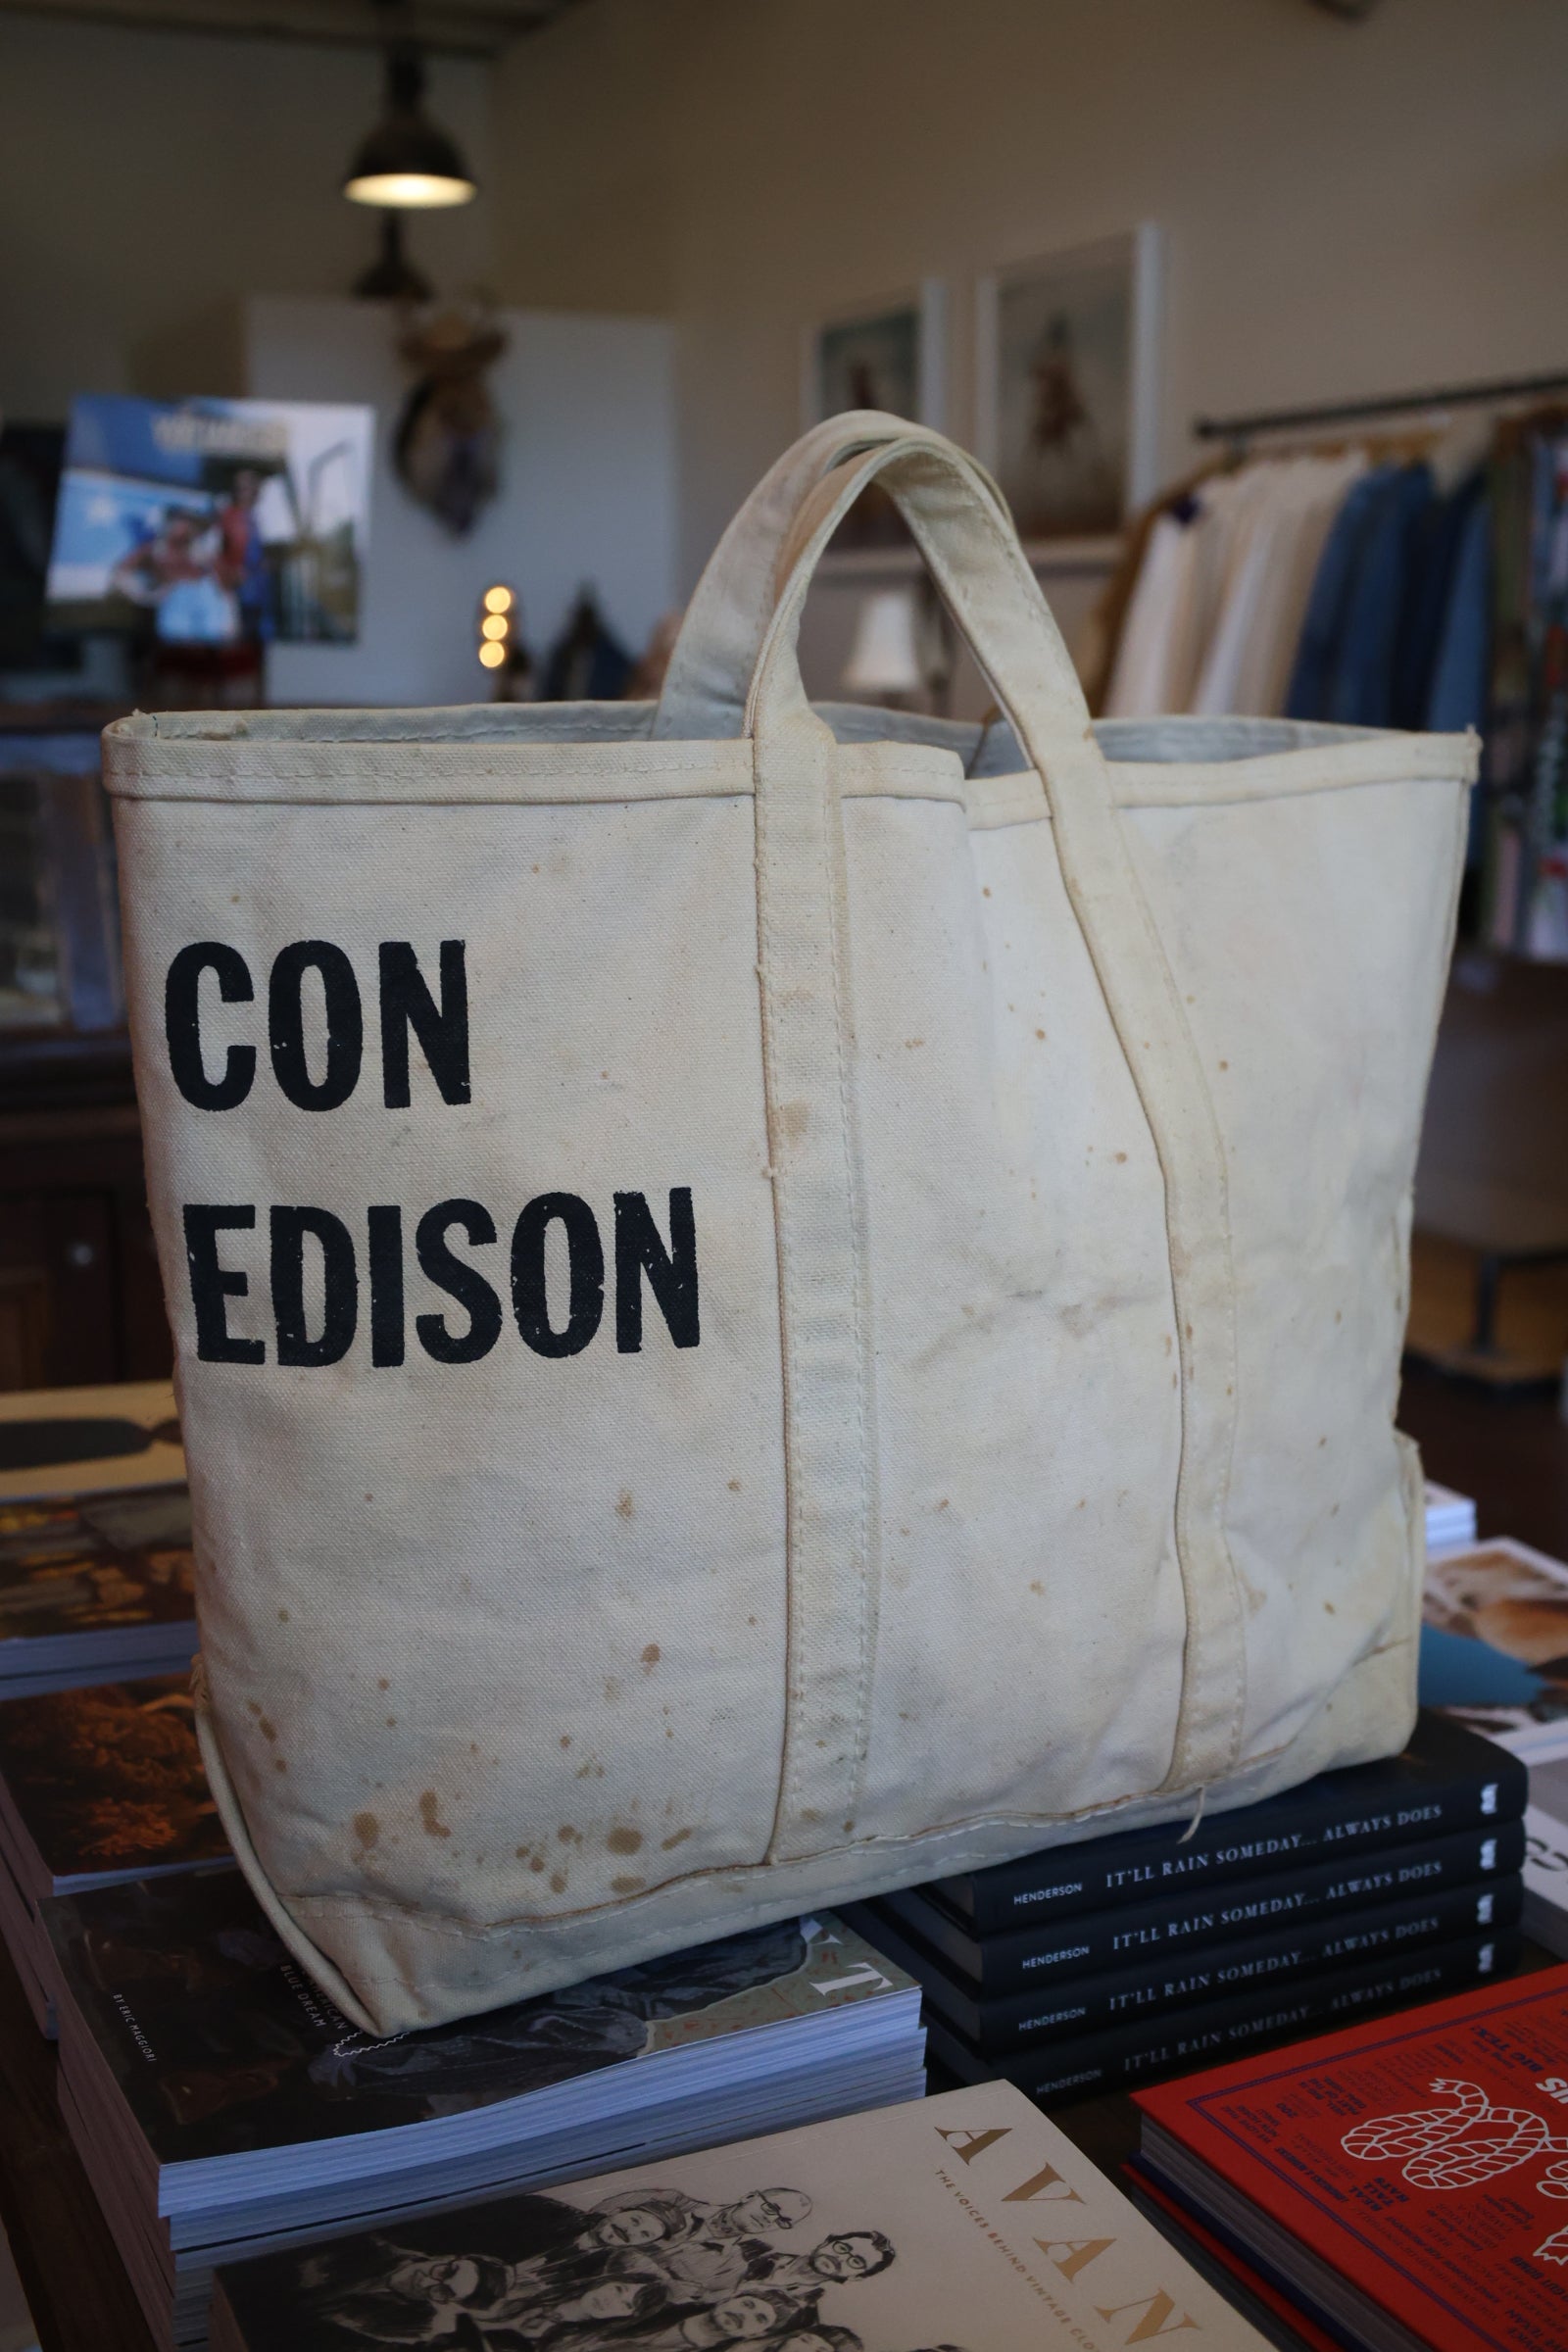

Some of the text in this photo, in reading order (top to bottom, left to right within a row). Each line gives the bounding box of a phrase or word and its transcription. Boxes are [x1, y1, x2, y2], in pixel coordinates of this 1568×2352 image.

[165, 940, 471, 1111] CON
[183, 1187, 700, 1367] EDISON
[1105, 1866, 1155, 1888] IT'LL
[1161, 1852, 1209, 1877] RAIN
[1323, 1815, 1392, 1841] ALWAYS
[1396, 1804, 1443, 1826] DOES
[1013, 1883, 1083, 1906] HENDERSON
[1112, 1928, 1161, 1951] IT'LL
[1167, 1913, 1215, 1937] RAIN
[1325, 1872, 1394, 1900] ALWAYS
[1398, 1861, 1443, 1884] DOES
[1022, 1945, 1091, 1970] HENDERSON
[1108, 1987, 1156, 2011] IT'LL
[1163, 1973, 1211, 1998] RAIN
[1322, 1929, 1390, 1958] ALWAYS
[1396, 1916, 1440, 1939] DOES
[280, 1964, 326, 2027] BLUE DREAM
[1018, 2007, 1087, 2033] HENDERSON
[1124, 2046, 1169, 2072] IT'LL
[1177, 2031, 1223, 2056] RAIN
[1332, 1981, 1395, 2009] ALWAYS
[1399, 1968, 1443, 1990] DOES
[113, 1993, 157, 2062] BY ERIC MAGGIORI
[1036, 2069, 1102, 2095] HENDERSON
[1510, 2050, 1544, 2073] BIG
[1347, 2186, 1382, 2210] REAL
[1361, 2182, 1396, 2206] TALL
[1374, 2177, 1409, 2201] HATS
[935, 2169, 956, 2189] THE
[954, 2191, 990, 2230] VOICES
[988, 2231, 1027, 2275] BEHIND
[1025, 2275, 1072, 2325] VINTAGE
